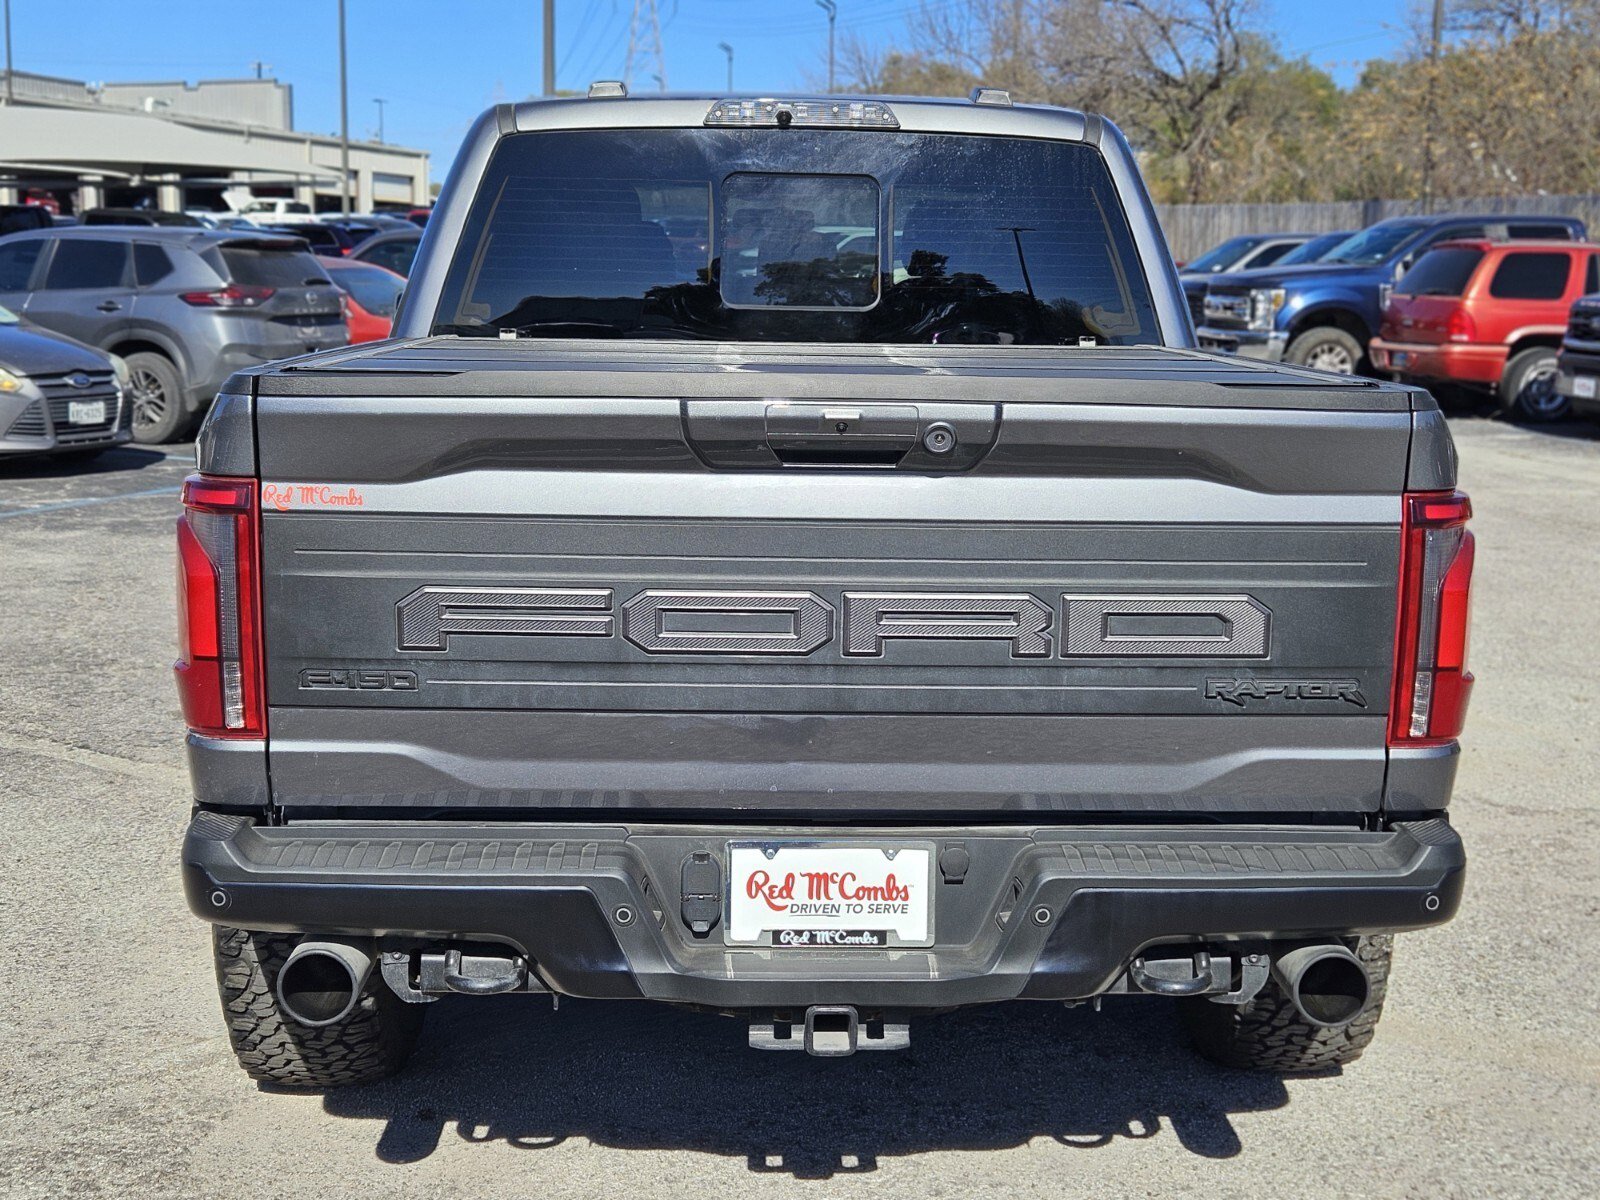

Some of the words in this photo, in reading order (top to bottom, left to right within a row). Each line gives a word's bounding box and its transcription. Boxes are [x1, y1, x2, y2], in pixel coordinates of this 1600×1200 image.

[263, 484, 293, 511] Red
[298, 486, 363, 505] McCombs
[395, 584, 1272, 660] FORD
[298, 668, 418, 691] F-150
[1204, 677, 1368, 708] RAPTOR
[746, 870, 795, 911] Red
[800, 872, 909, 901] McCombs
[790, 903, 841, 914] DRIVEN
[845, 903, 864, 914] TO
[867, 903, 909, 914] SERVE
[780, 931, 810, 945] Red
[812, 931, 878, 944] McCombs
